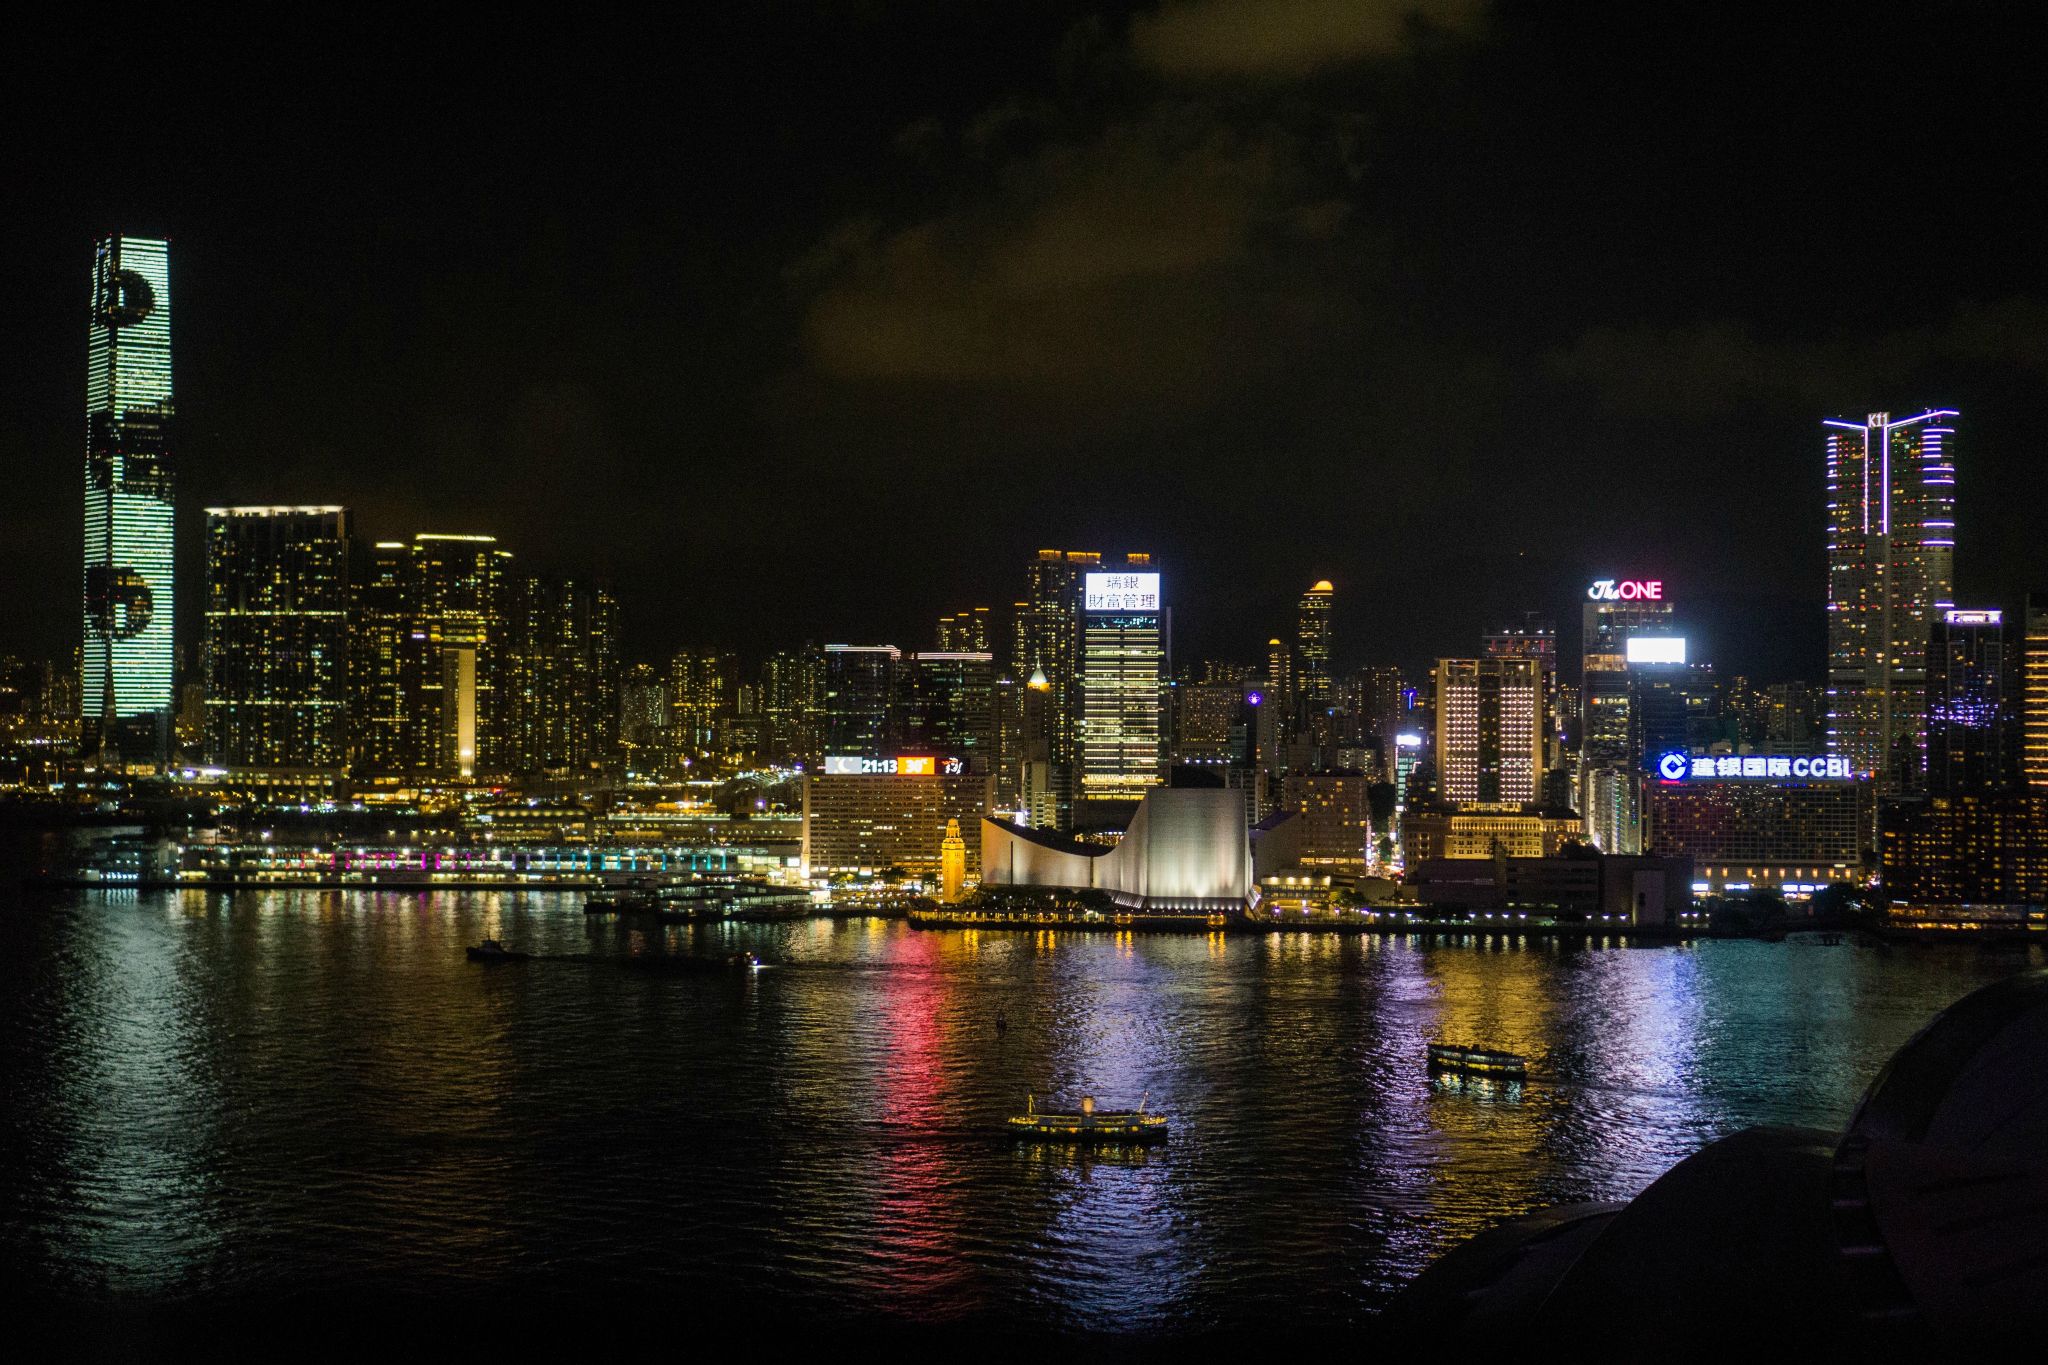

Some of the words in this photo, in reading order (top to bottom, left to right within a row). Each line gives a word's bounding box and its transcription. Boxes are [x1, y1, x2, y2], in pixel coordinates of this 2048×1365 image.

[1867, 412, 1889, 428] K11
[1106, 575, 1140, 590] 瑞銀
[1619, 581, 1663, 600] ONE
[1088, 593, 1156, 609] 財富管理
[862, 759, 898, 774] 21:13
